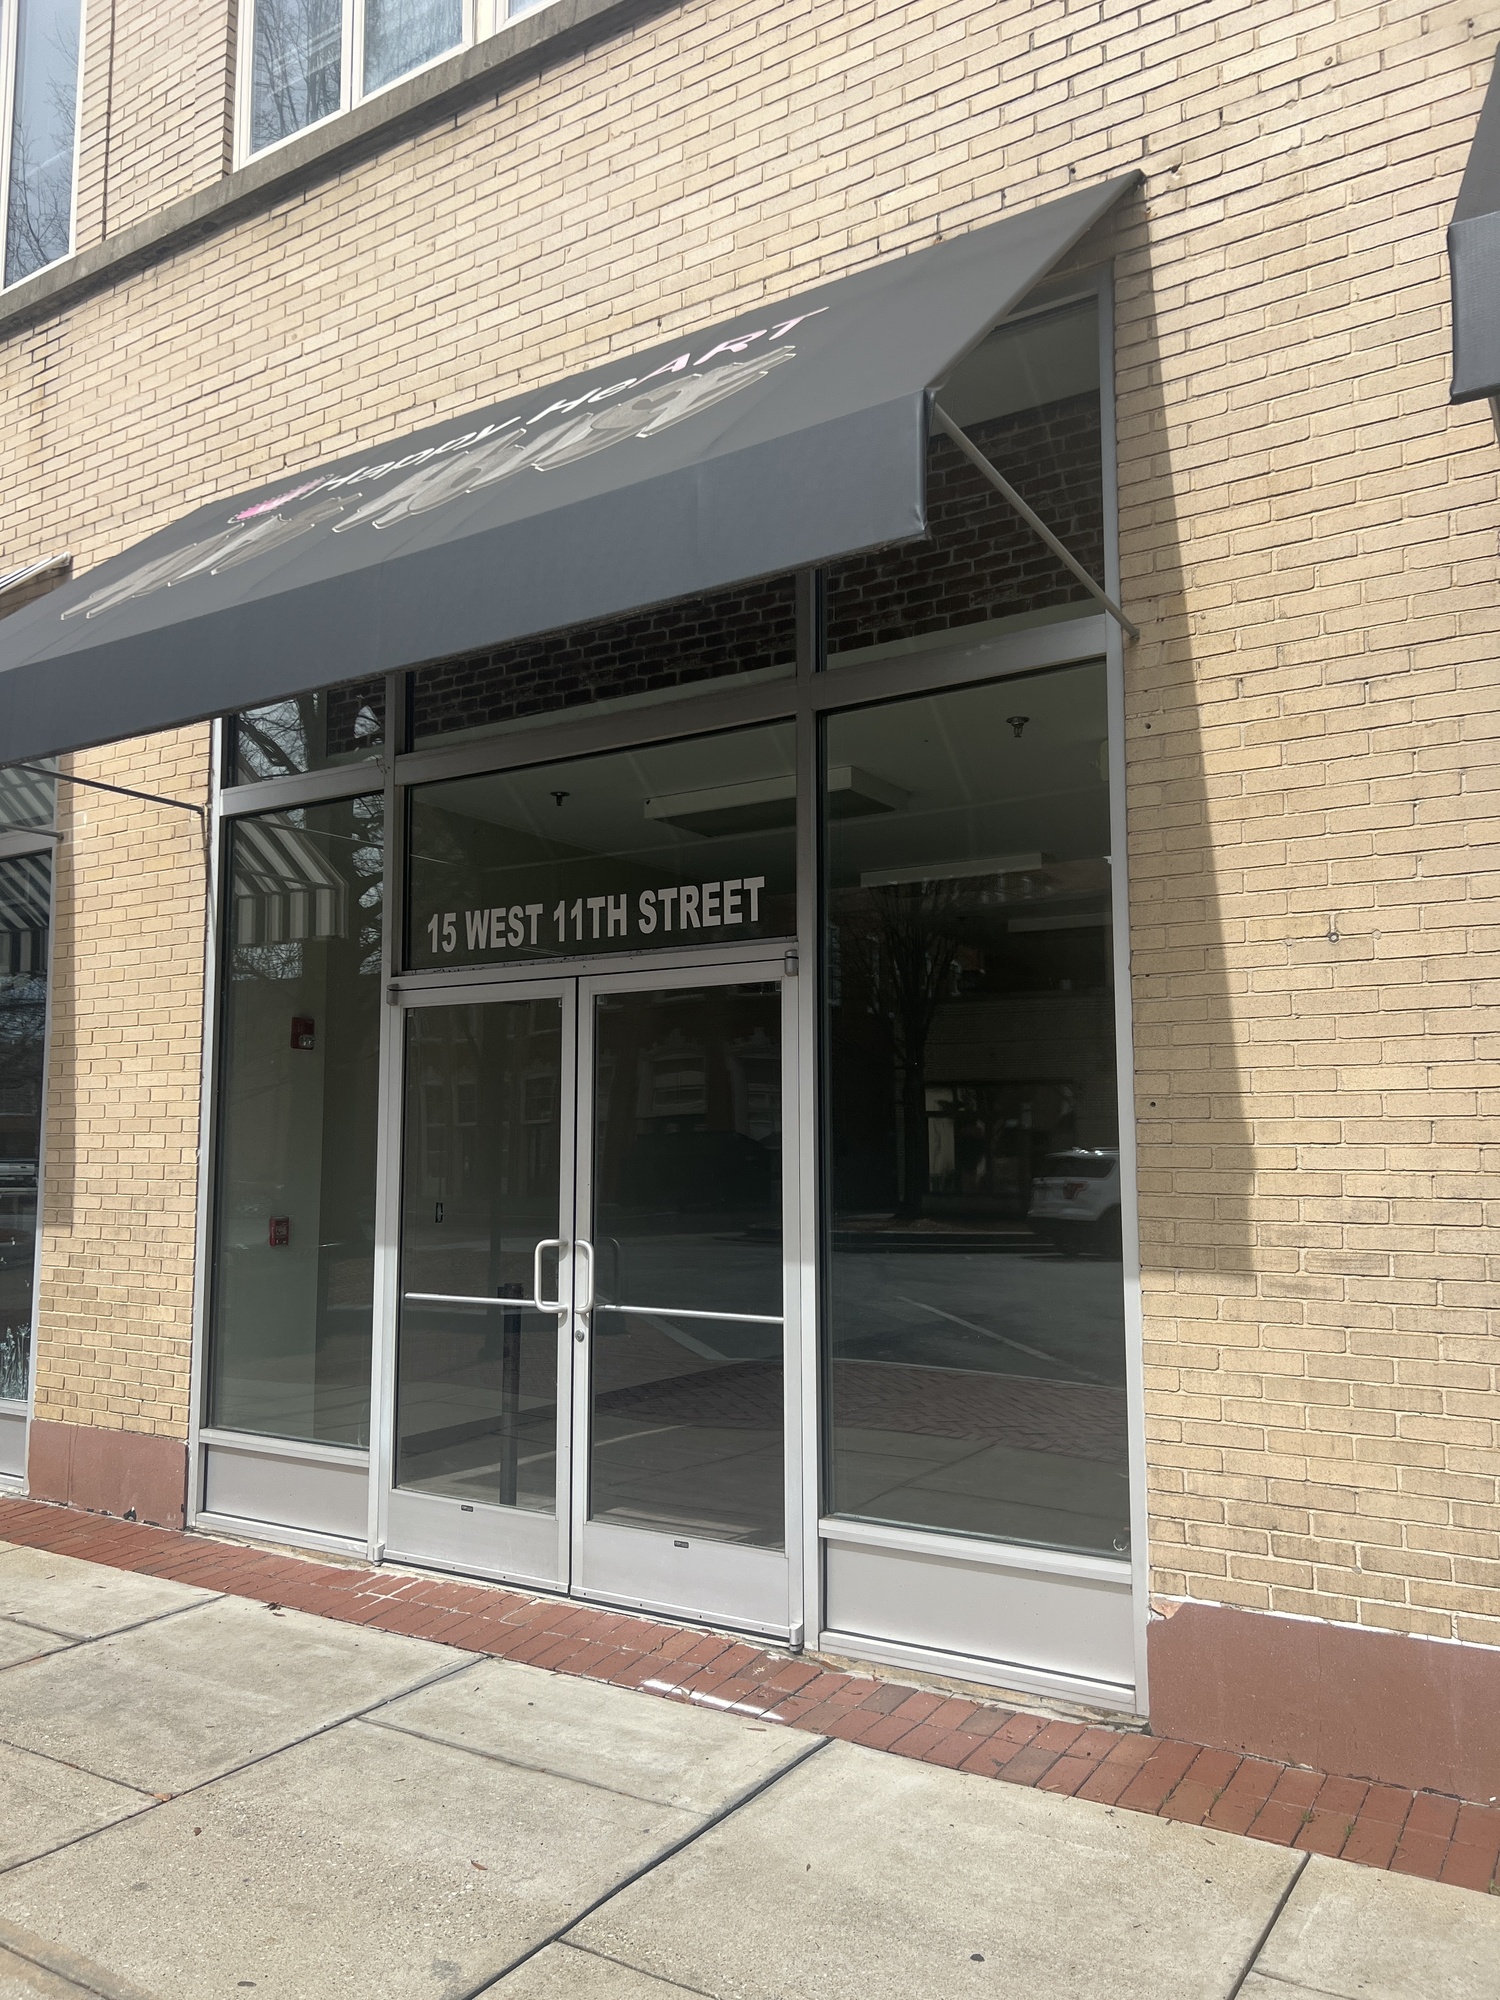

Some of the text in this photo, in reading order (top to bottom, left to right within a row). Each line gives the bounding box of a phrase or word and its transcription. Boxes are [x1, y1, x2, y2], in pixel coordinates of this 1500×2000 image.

[300, 307, 831, 500] Happy HeART
[332, 346, 797, 532] HOUSE
[427, 876, 765, 953] 15 WEST 11TH STREET
